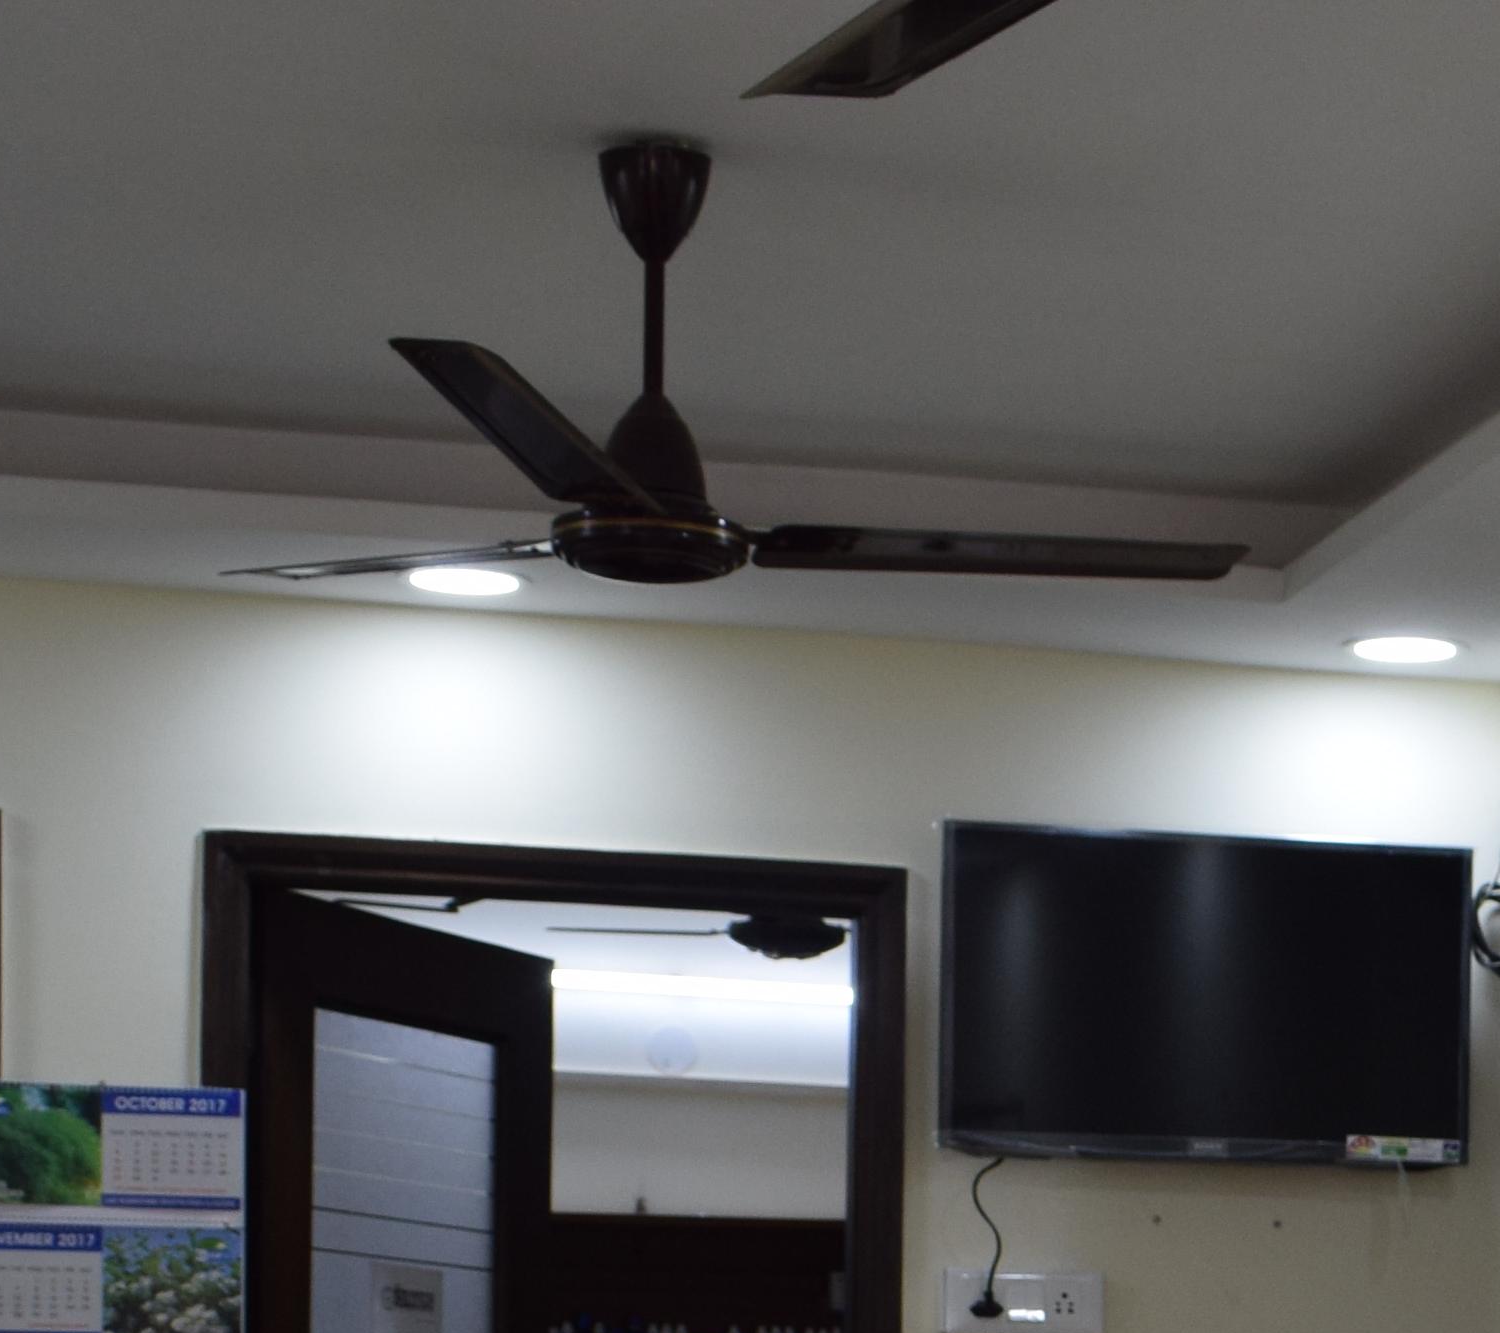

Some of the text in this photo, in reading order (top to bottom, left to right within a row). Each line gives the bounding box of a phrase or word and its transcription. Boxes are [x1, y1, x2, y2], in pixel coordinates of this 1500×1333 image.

[114, 1095, 227, 1114] OCTOBER 2017
[57, 1233, 95, 1249] 2017
